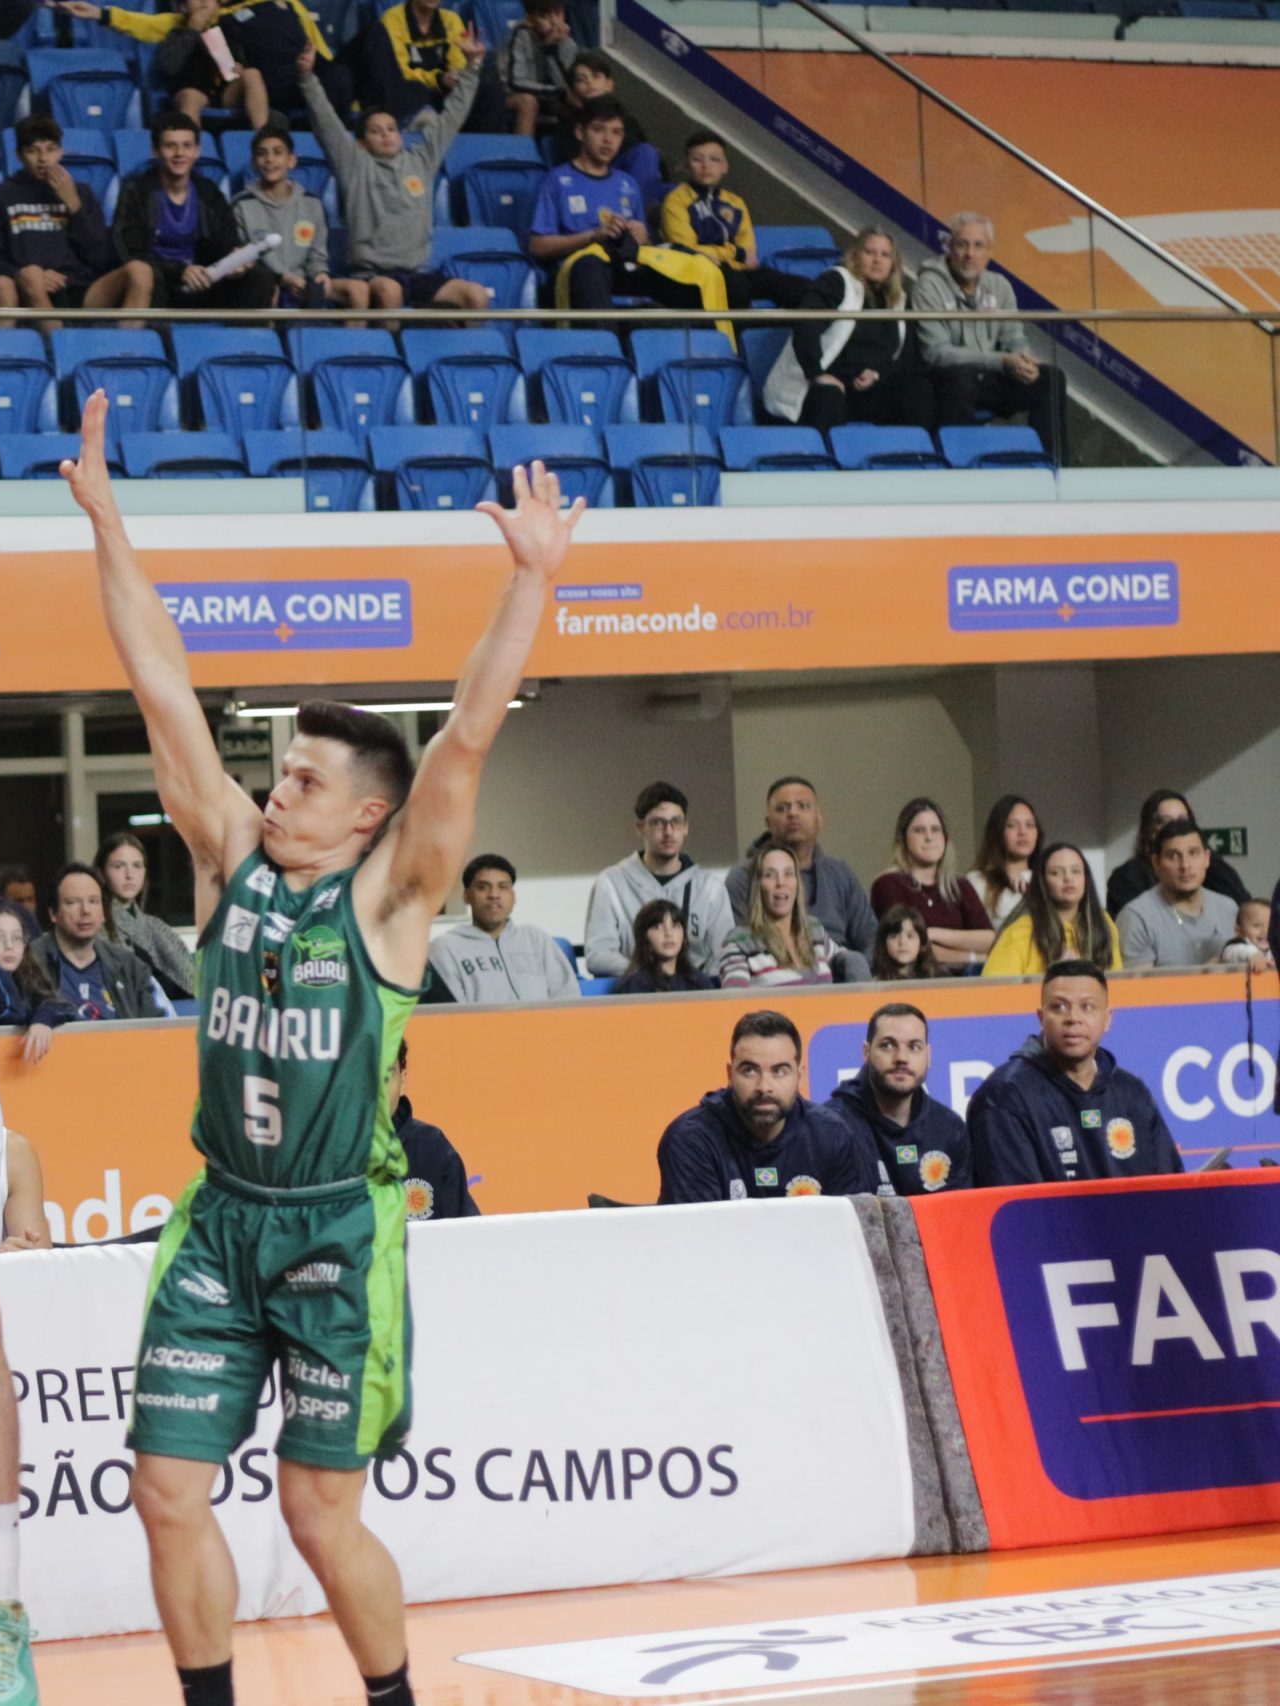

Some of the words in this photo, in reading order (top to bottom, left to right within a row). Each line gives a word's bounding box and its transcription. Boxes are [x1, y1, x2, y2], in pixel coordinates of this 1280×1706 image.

[956, 578, 1058, 606] FARMA
[1066, 574, 1171, 602] CONDE
[163, 596, 277, 624] FARMA
[285, 592, 402, 622] CONDE
[556, 604, 815, 636] farmaconde.com.br
[293, 960, 348, 983] BAURU
[207, 987, 341, 1060] BAURU
[243, 1075, 283, 1146] 5
[298, 1396, 350, 1420] SPSP
[19, 1449, 134, 1519] SÃO
[474, 1444, 739, 1504] CAMPOS
[864, 1588, 1206, 1630] FORMAÇÃO
[1208, 1579, 1280, 1595] DE
